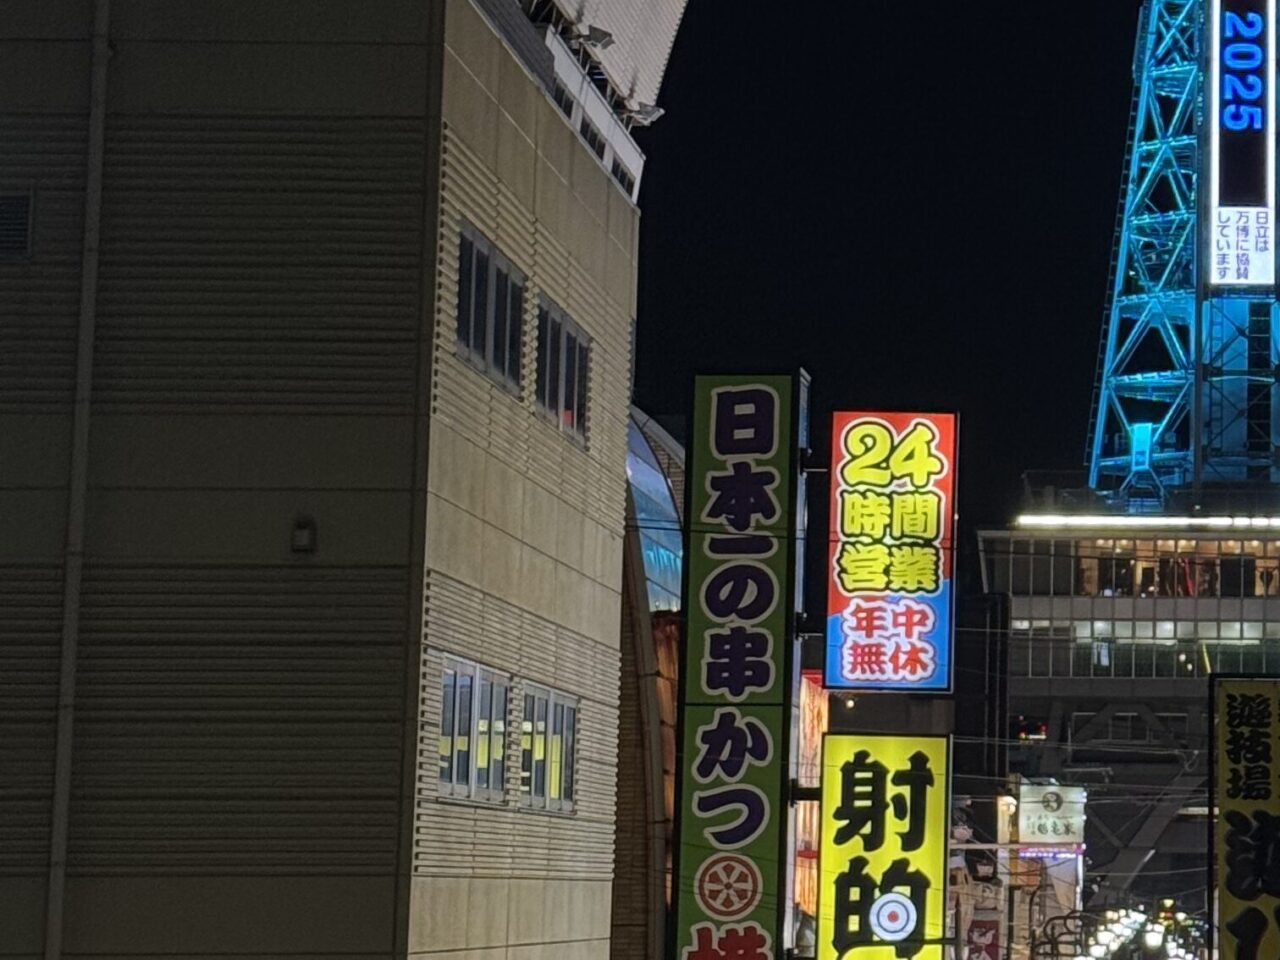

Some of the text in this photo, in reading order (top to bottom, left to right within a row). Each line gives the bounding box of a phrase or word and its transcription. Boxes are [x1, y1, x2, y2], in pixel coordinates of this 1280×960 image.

[1223, 11, 1264, 130] 2025
[1216, 211, 1230, 279] しています
[1255, 211, 1269, 252] 日立は
[841, 420, 945, 488] 24
[840, 489, 942, 540] 時間
[836, 541, 940, 593] 営業
[693, 386, 779, 846] 日本一の串かつ
[848, 603, 931, 639] 年中
[847, 640, 931, 676] 無休
[833, 749, 936, 959] 射的
